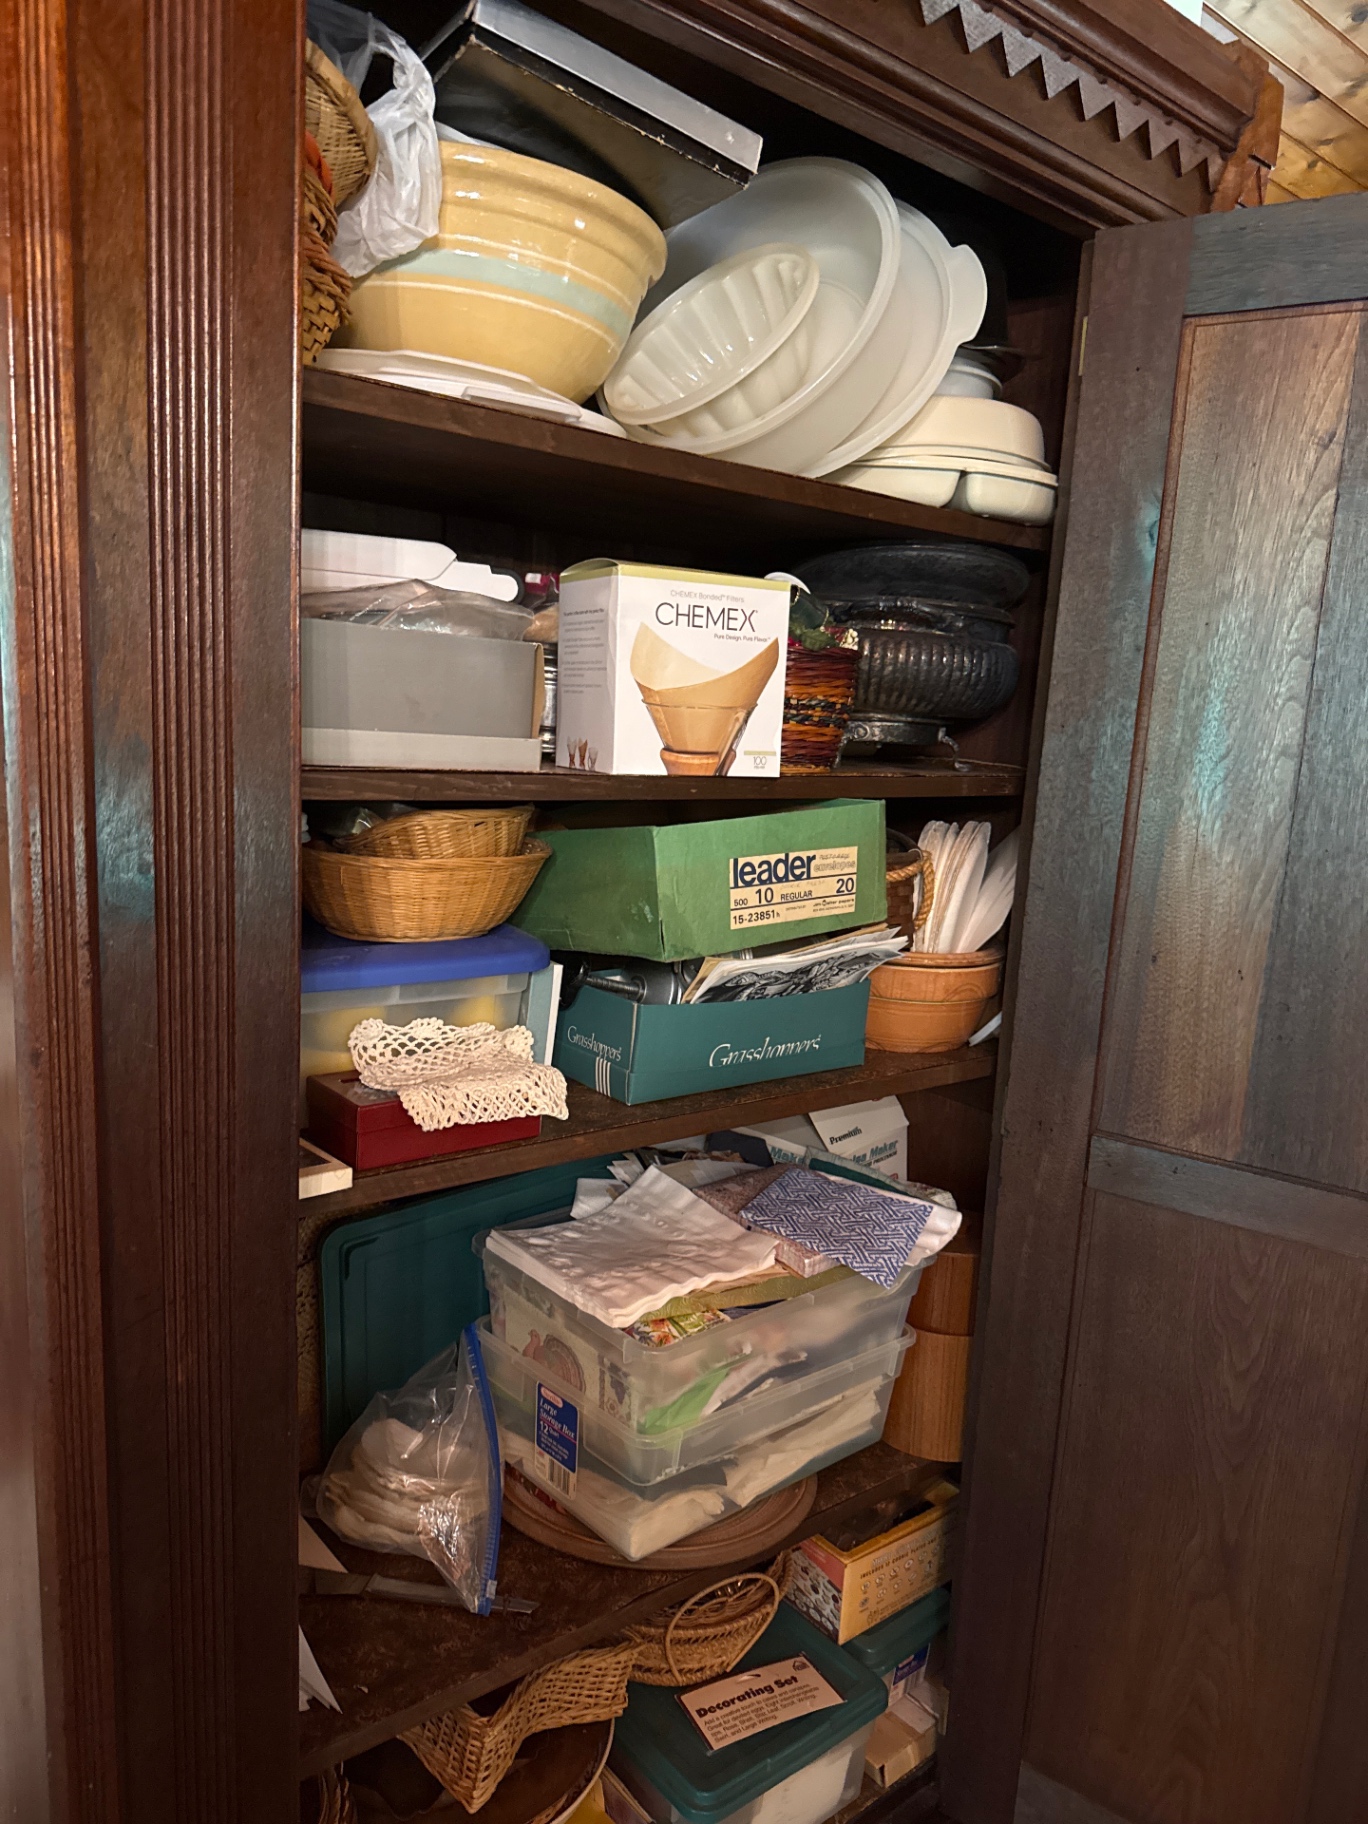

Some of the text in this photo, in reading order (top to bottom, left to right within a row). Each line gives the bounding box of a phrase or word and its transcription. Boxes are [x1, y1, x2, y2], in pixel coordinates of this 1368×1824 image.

[670, 589, 698, 599] CHEMEX
[753, 756, 768, 766] 100
[733, 853, 816, 888] leader
[733, 898, 749, 907] 500
[755, 887, 774, 904] 10
[780, 890, 813, 901] REGULAR
[836, 877, 855, 894] 20
[540, 1397, 558, 1416] Large
[540, 1420, 549, 1435] 12
[562, 1423, 576, 1439] Box
[695, 1675, 798, 1718] Decorating Set
